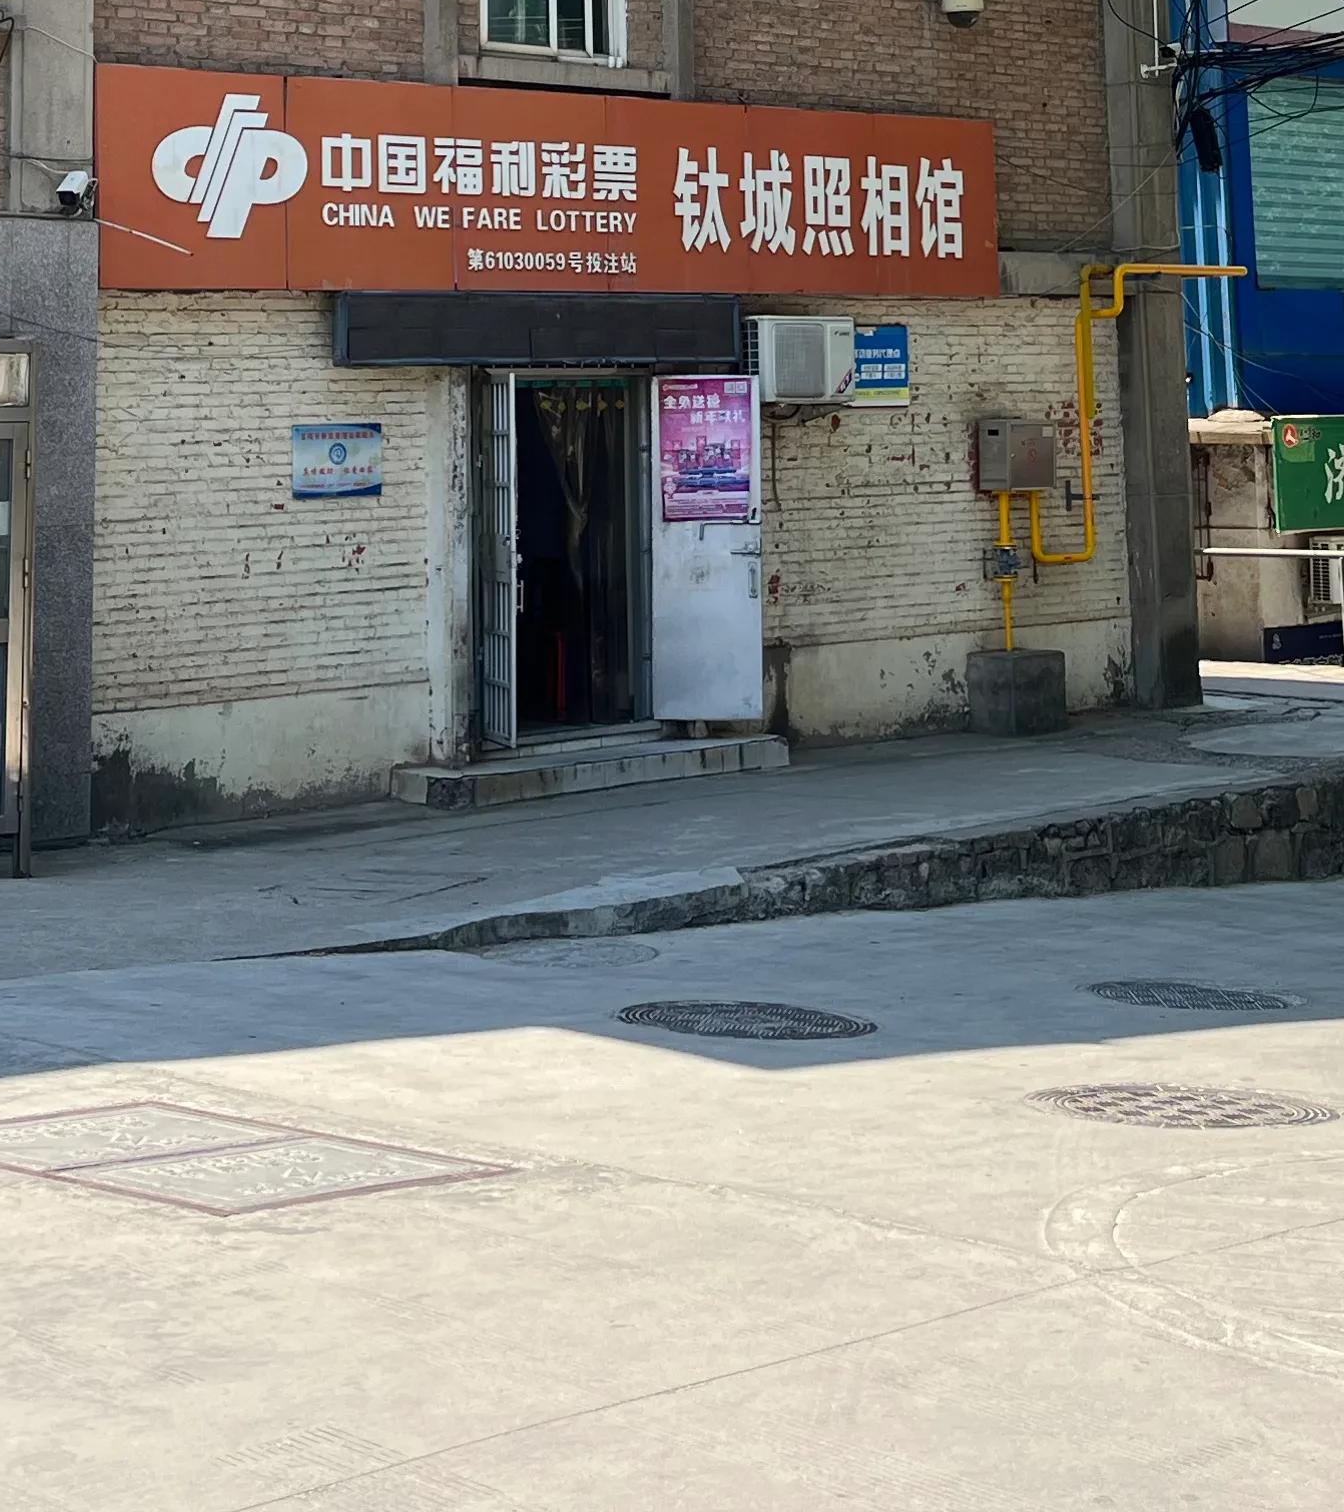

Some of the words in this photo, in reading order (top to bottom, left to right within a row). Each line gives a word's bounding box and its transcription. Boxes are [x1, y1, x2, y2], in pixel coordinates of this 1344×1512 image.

[321, 133, 639, 201] 中国福利彩票
[321, 202, 395, 229] CHINA
[536, 208, 638, 234] LOTTERY
[672, 145, 966, 260] 钛城照相馆
[466, 247, 638, 276] 第61030059号投注站
